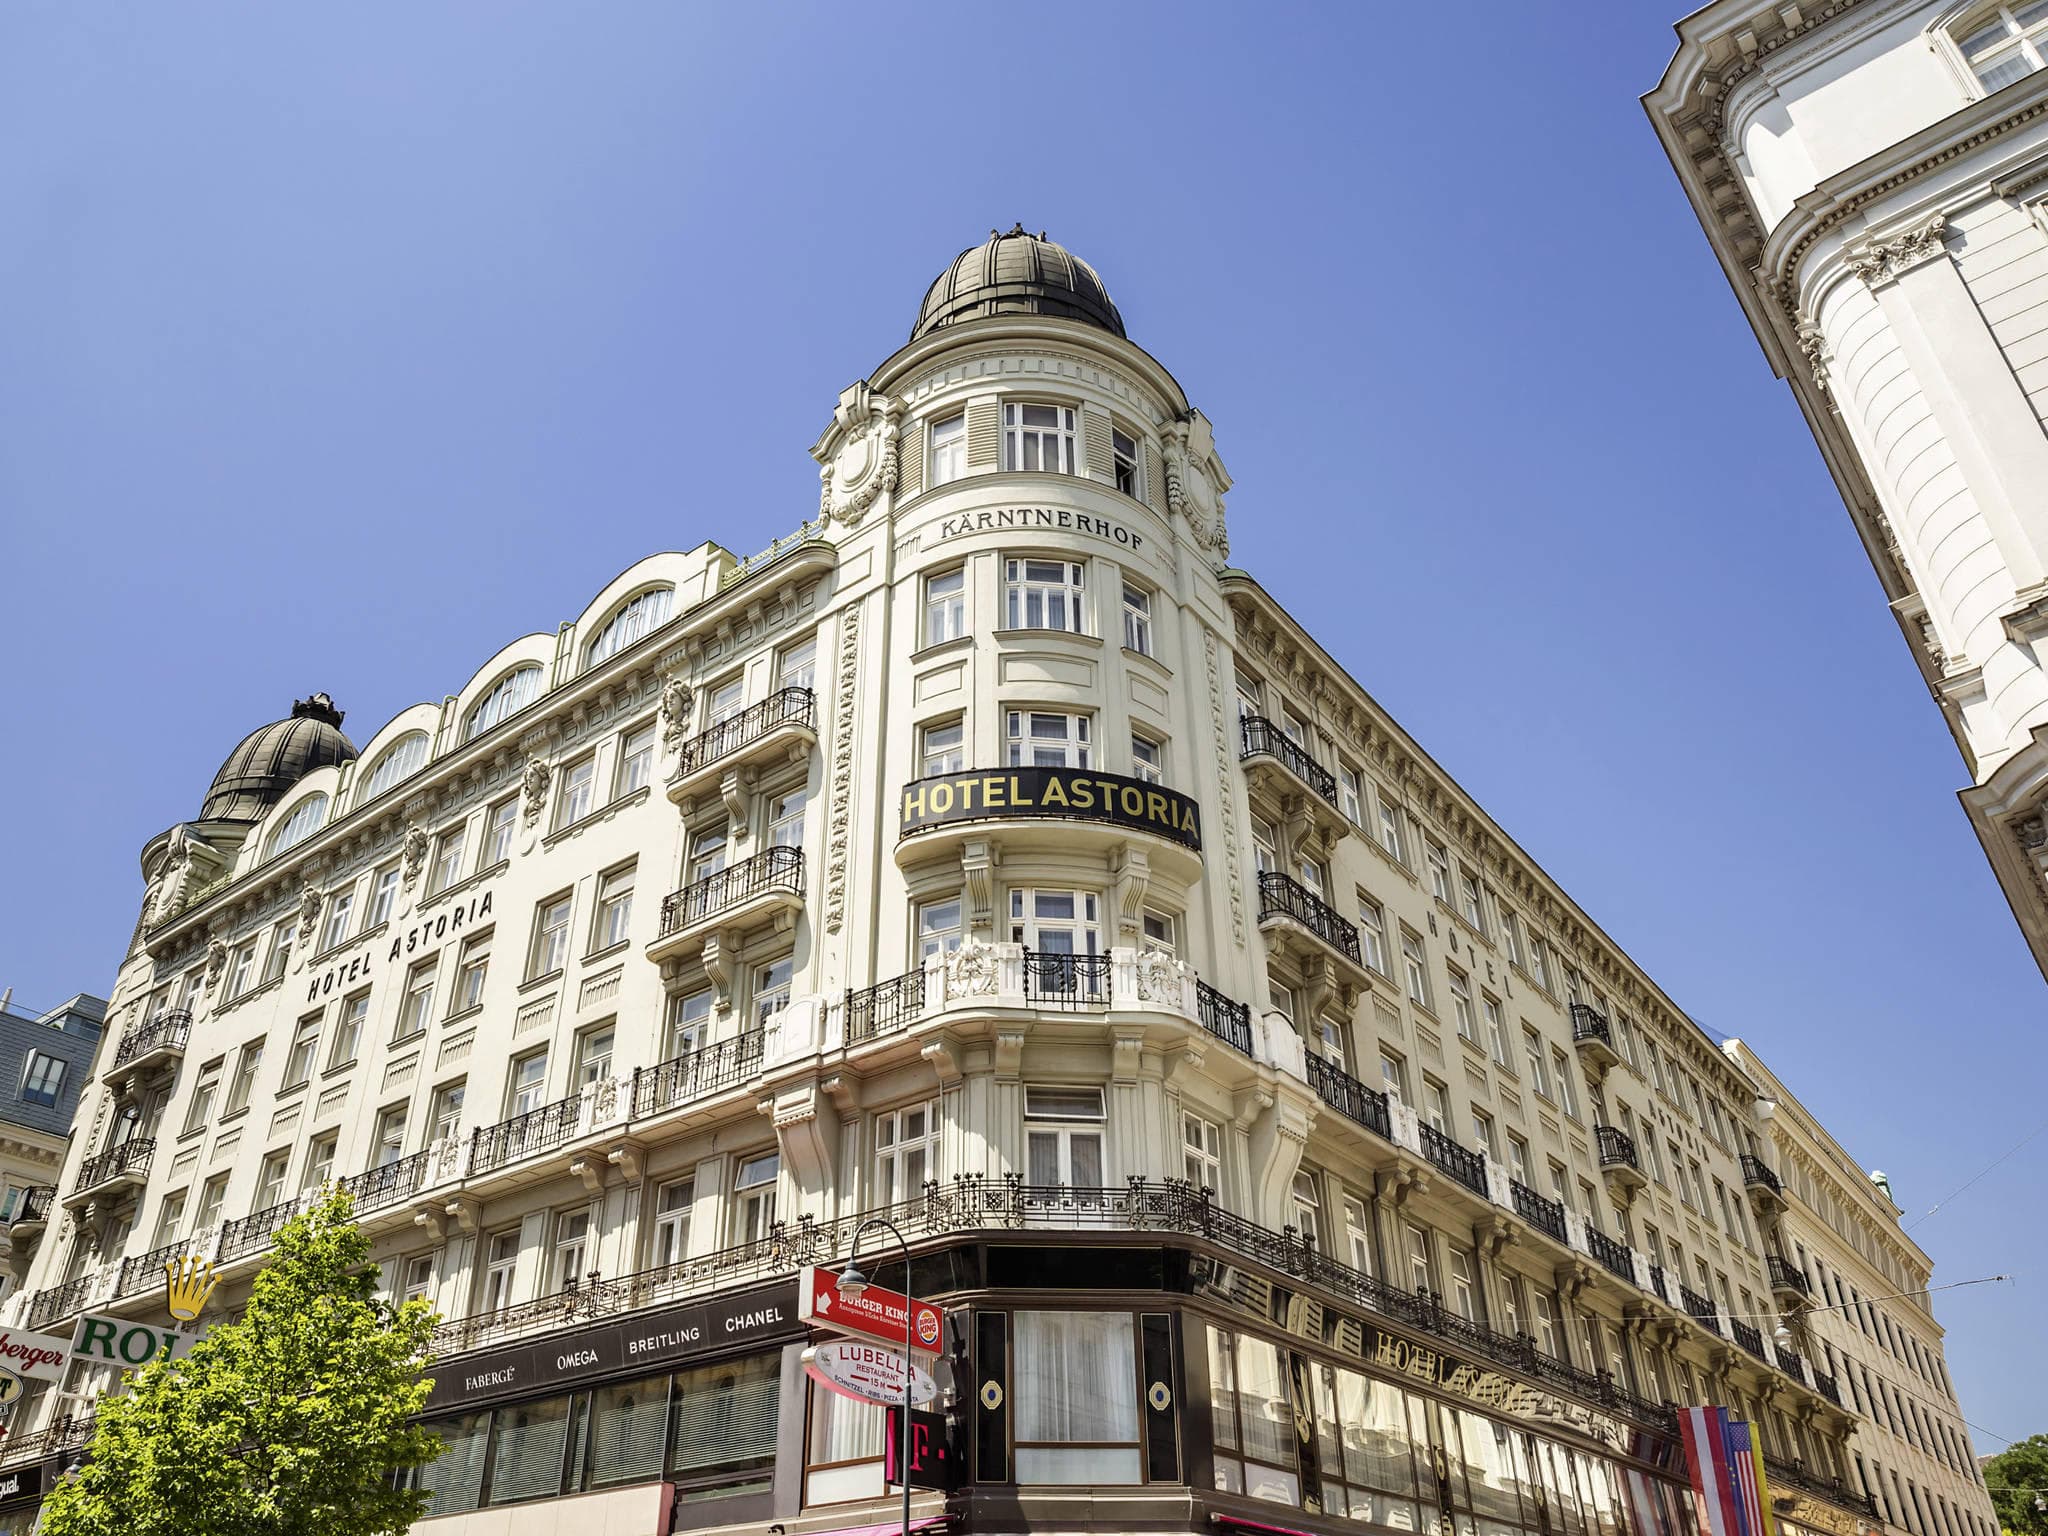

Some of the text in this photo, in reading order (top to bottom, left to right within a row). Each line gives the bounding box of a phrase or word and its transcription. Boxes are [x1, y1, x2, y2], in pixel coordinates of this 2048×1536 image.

[941, 508, 1143, 551] KÄRNTNERHOF
[904, 776, 1198, 839] HOTEL ASTORIA
[308, 891, 493, 1002] HOTEL ASTORIA
[1426, 910, 1513, 1000] HOTEL
[1648, 1098, 1710, 1164] ASTORIA
[725, 1307, 783, 1332] CHANEL
[920, 1324, 937, 1333] KING
[75, 1318, 207, 1370] ROL
[629, 1327, 700, 1354] BREITLING
[557, 1349, 599, 1370] OMEGA
[840, 1346, 916, 1381] LUBELLA
[856, 1363, 900, 1382] RESTAURANT
[1376, 1332, 1448, 1389] HOTEL
[834, 1375, 864, 1393] SCHNITZEL
[868, 1389, 880, 1398] RIBS
[884, 1394, 898, 1402] PIZZA
[870, 1378, 879, 1387] 15
